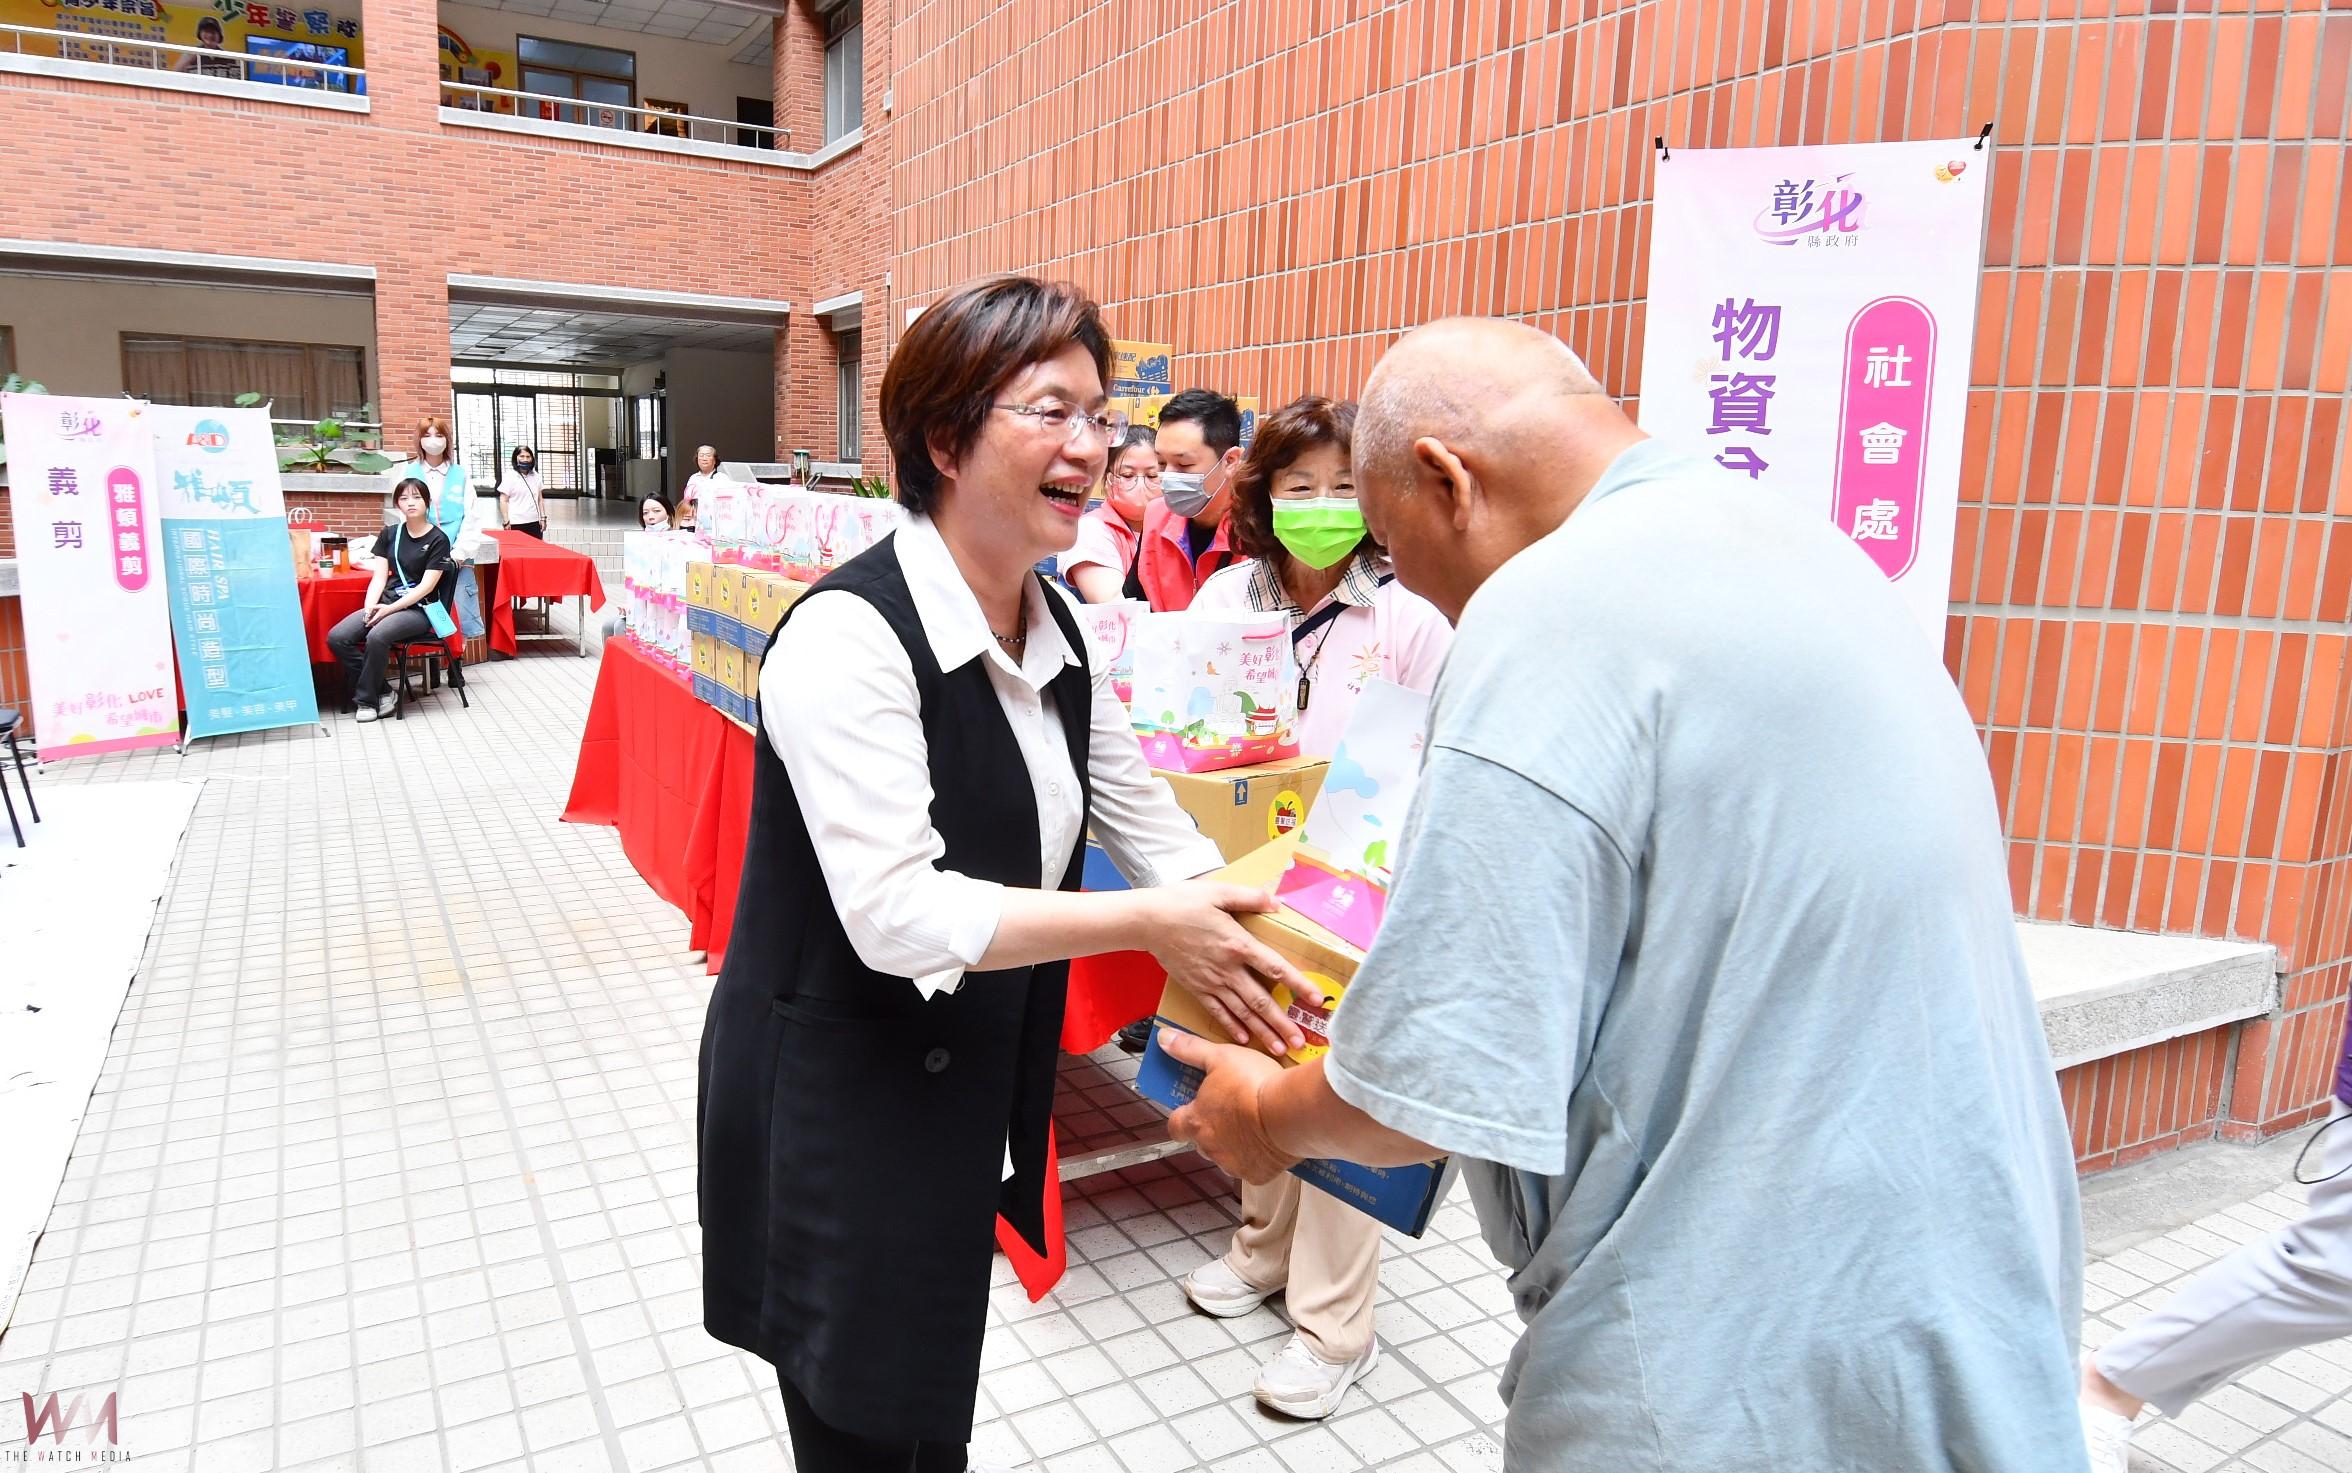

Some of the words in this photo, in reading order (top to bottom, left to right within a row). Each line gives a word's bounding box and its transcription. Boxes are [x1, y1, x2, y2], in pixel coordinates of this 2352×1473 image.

[1771, 179, 1863, 233] 彰化
[1807, 235, 1859, 248] 縣政府
[1851, 344, 1912, 541] 社會處
[48, 466, 82, 549] 義剪
[112, 483, 143, 576] 雅頓義剪
[128, 688, 165, 704] LOVE
